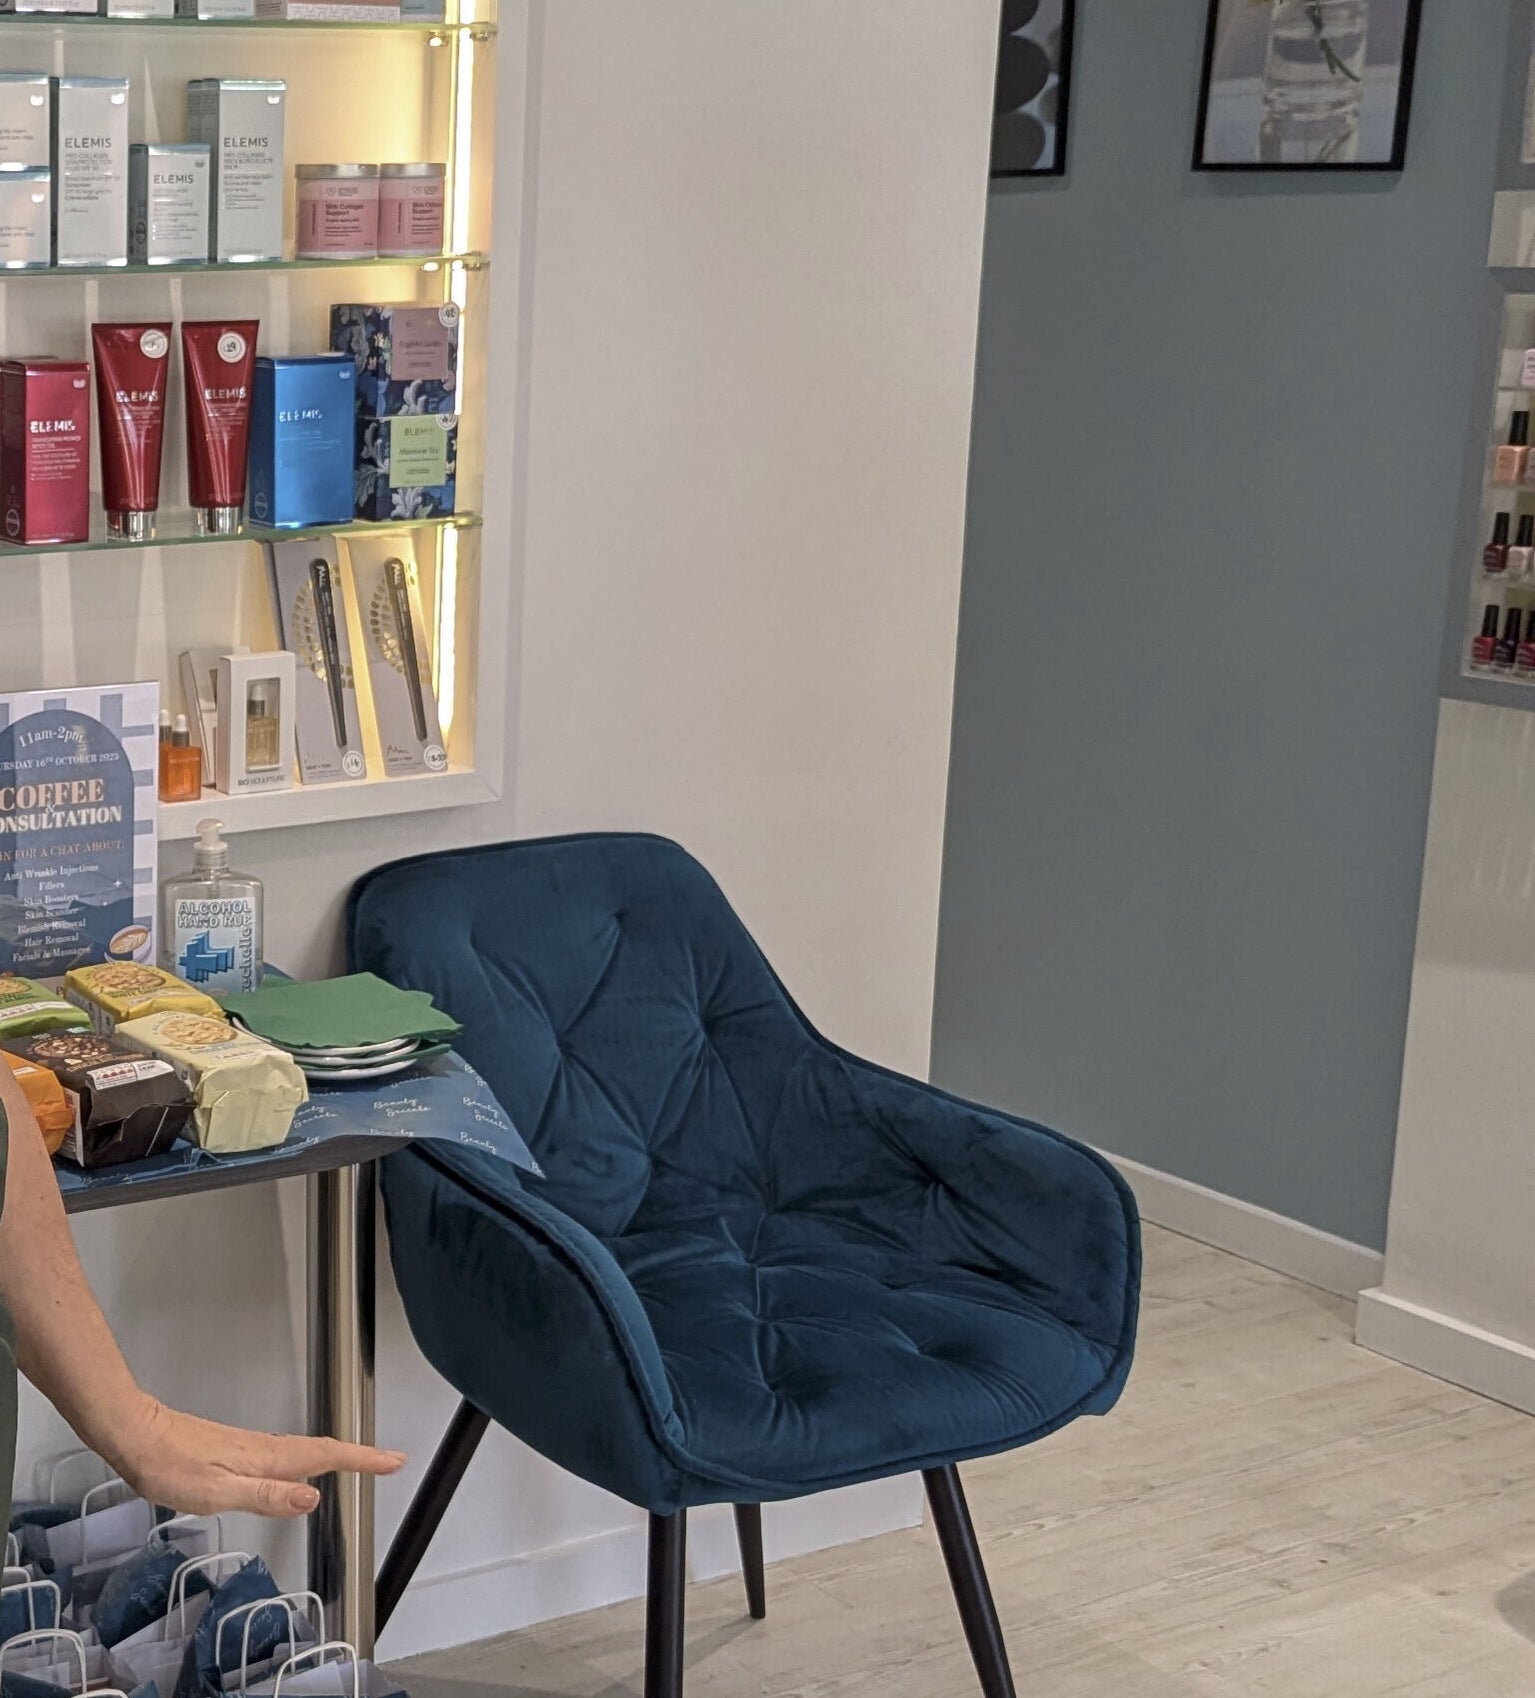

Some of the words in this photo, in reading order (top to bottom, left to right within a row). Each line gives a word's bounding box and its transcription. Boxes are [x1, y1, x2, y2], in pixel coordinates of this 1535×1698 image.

[64, 137, 112, 149] ELEMIS
[223, 137, 269, 148] ELEMIS
[153, 174, 194, 185] ELEMIS
[204, 386, 247, 400] ELEMIS
[30, 419, 76, 433] ELEMIS
[18, 725, 85, 748] 11am-2pm
[45, 802, 57, 815] &
[15, 848, 37, 860] FOR
[40, 847, 49, 858] A
[50, 843, 81, 857] CHAT
[4, 871, 22, 881] Anti
[24, 866, 58, 879] Wrinkle
[59, 864, 99, 877] Injections
[38, 882, 65, 891] Fillers
[178, 900, 252, 915] ALCOHOL
[24, 910, 44, 920] Skin
[178, 914, 220, 928] HAND
[223, 913, 252, 928] RUB
[24, 937, 44, 947] Hair
[45, 932, 80, 944] Removal
[12, 951, 41, 962] Facials
[239, 926, 253, 993] echelle
